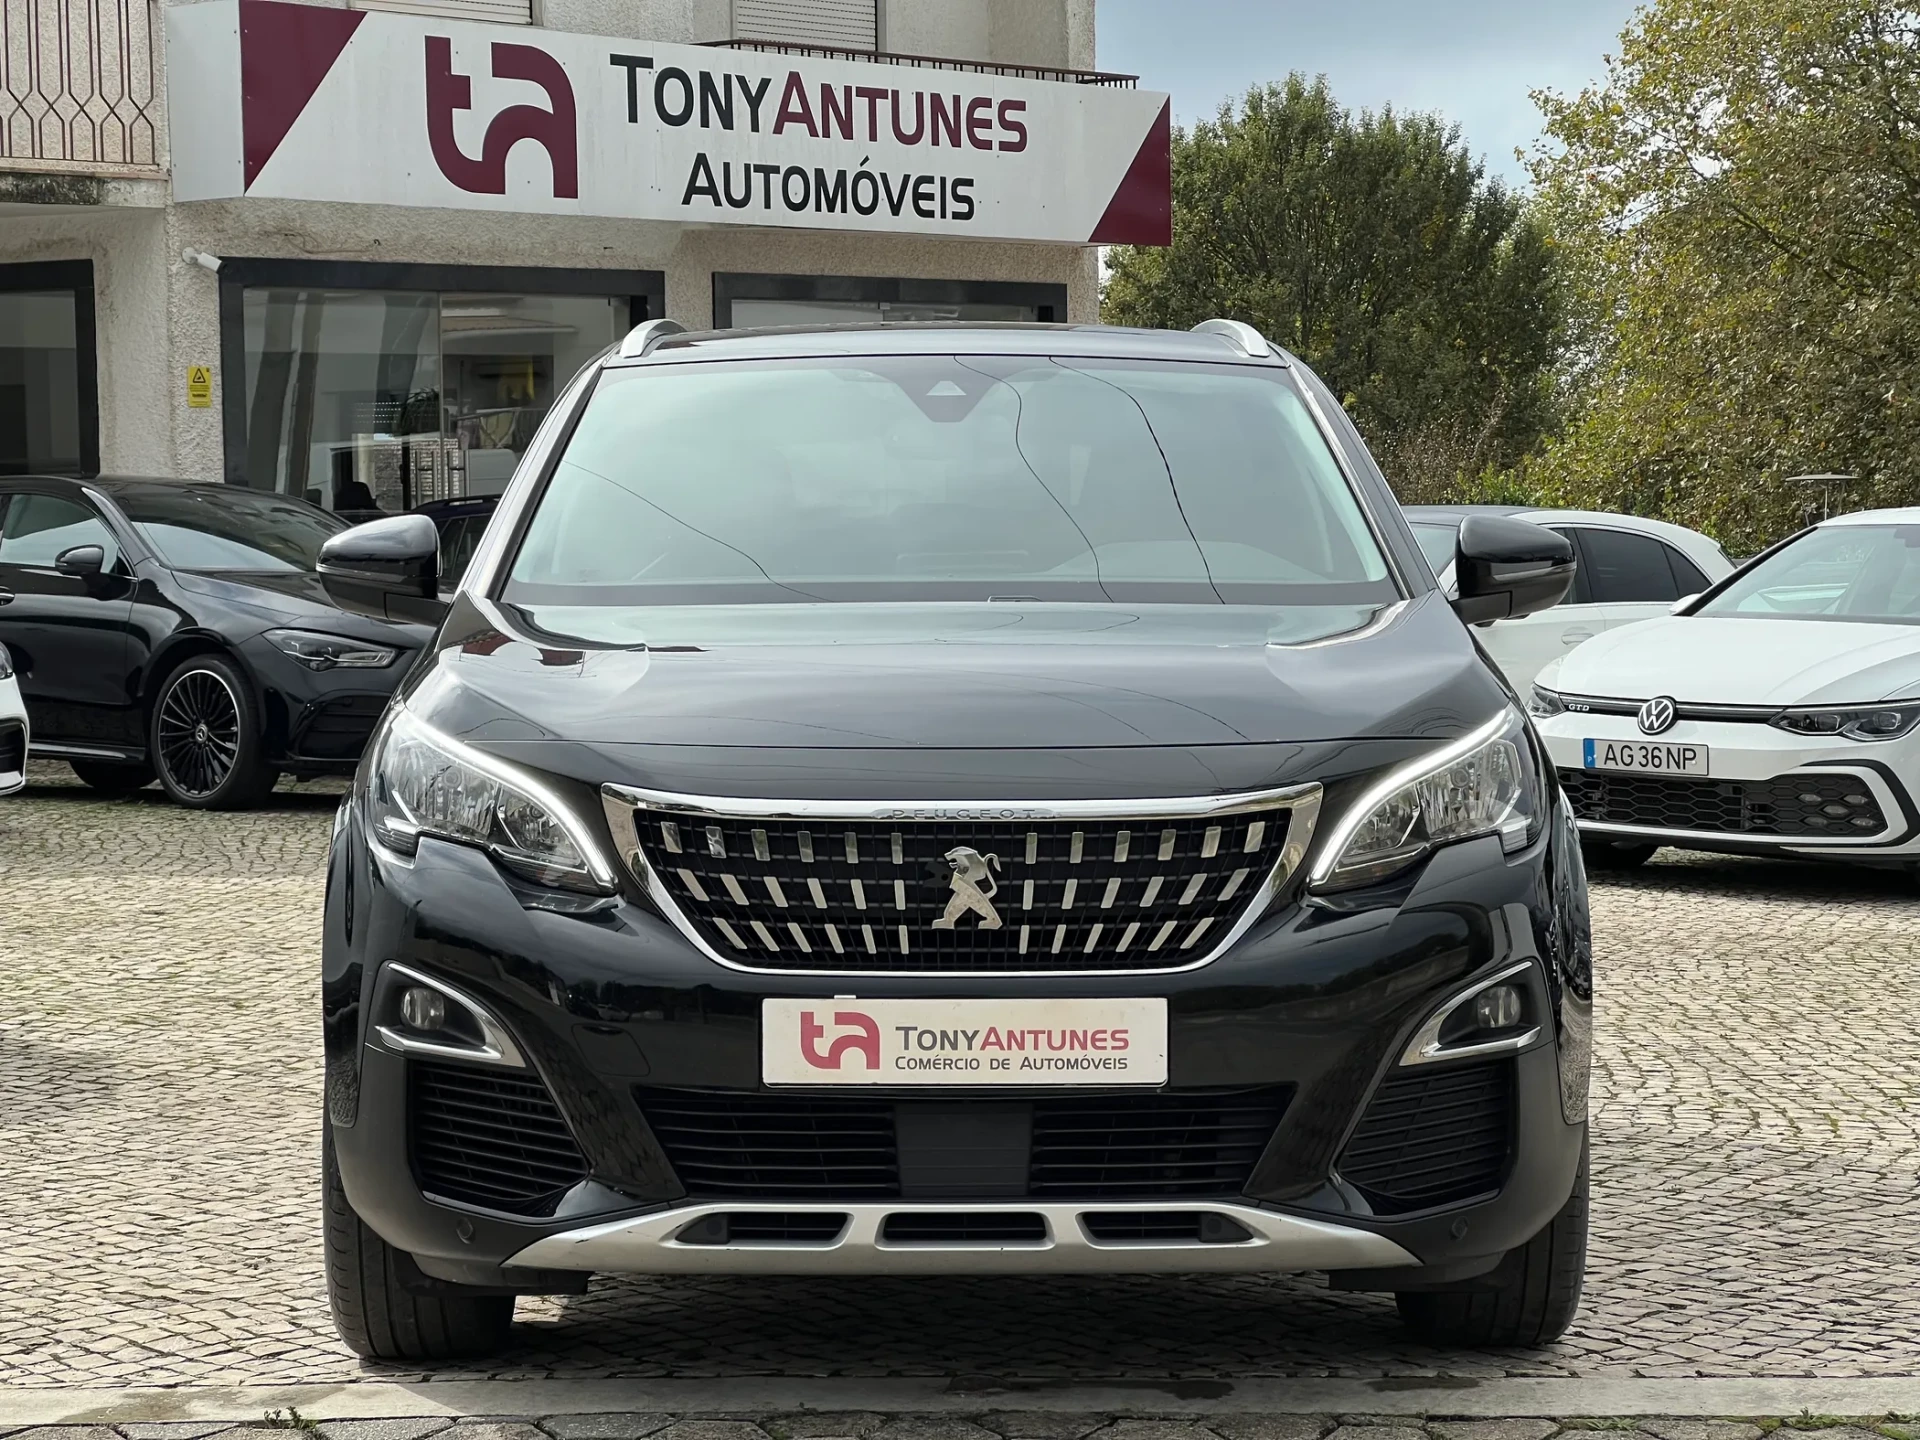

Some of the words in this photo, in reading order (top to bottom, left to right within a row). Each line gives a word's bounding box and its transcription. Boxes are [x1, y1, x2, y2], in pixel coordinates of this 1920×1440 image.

[681, 152, 975, 221] AUTOMÓVEIS
[1568, 703, 1590, 711] GTD
[892, 809, 1036, 820] PEUGEOT
[895, 1054, 980, 1071] COMÉRCIO
[989, 1058, 1011, 1071] DE
[1020, 1054, 1128, 1071] AUTOMÓVEIS
